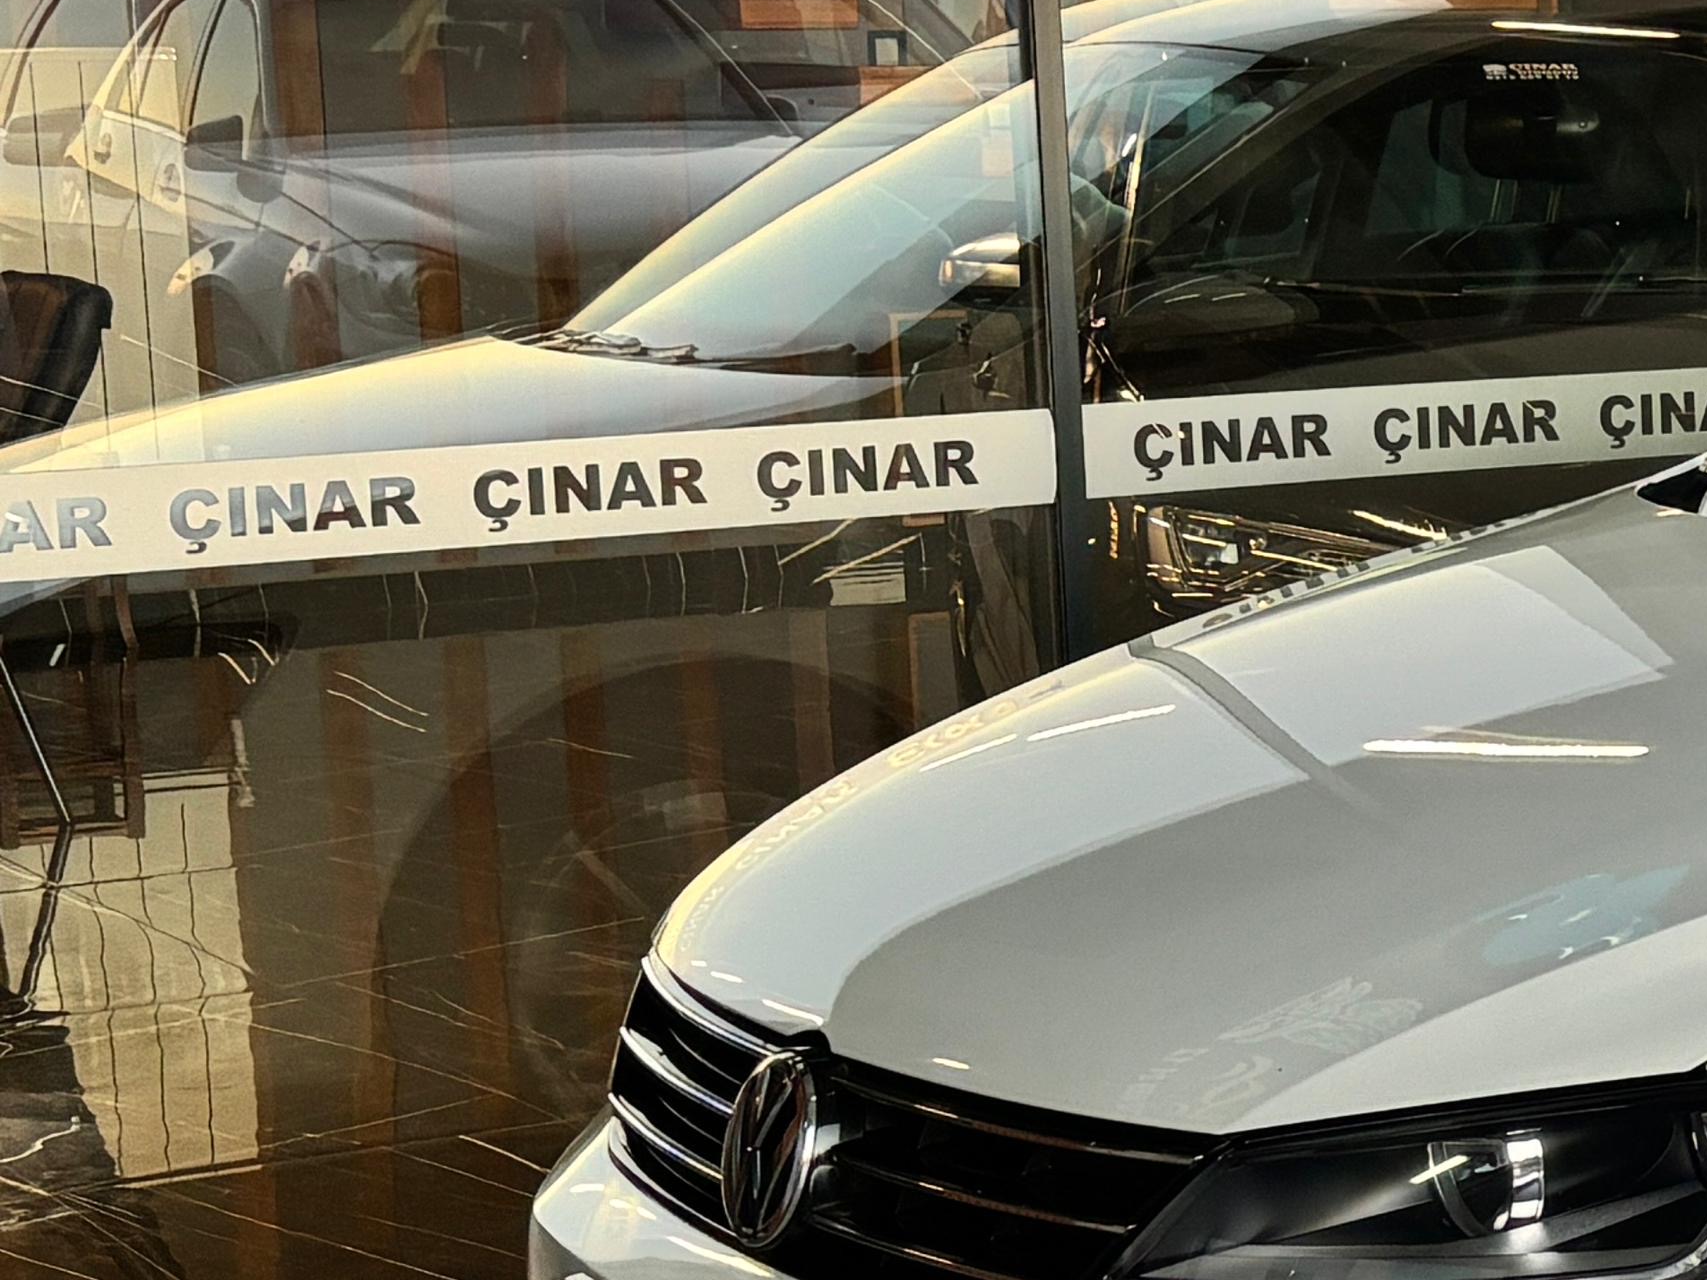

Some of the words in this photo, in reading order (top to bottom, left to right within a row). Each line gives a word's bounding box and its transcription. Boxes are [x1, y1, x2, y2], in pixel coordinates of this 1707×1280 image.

[1133, 412, 1331, 482] ÇINAR
[1373, 397, 1561, 465] ÇINAR
[170, 475, 420, 555] ÇINAR
[472, 457, 708, 532] ÇINAR
[755, 438, 980, 515] ÇINAR
